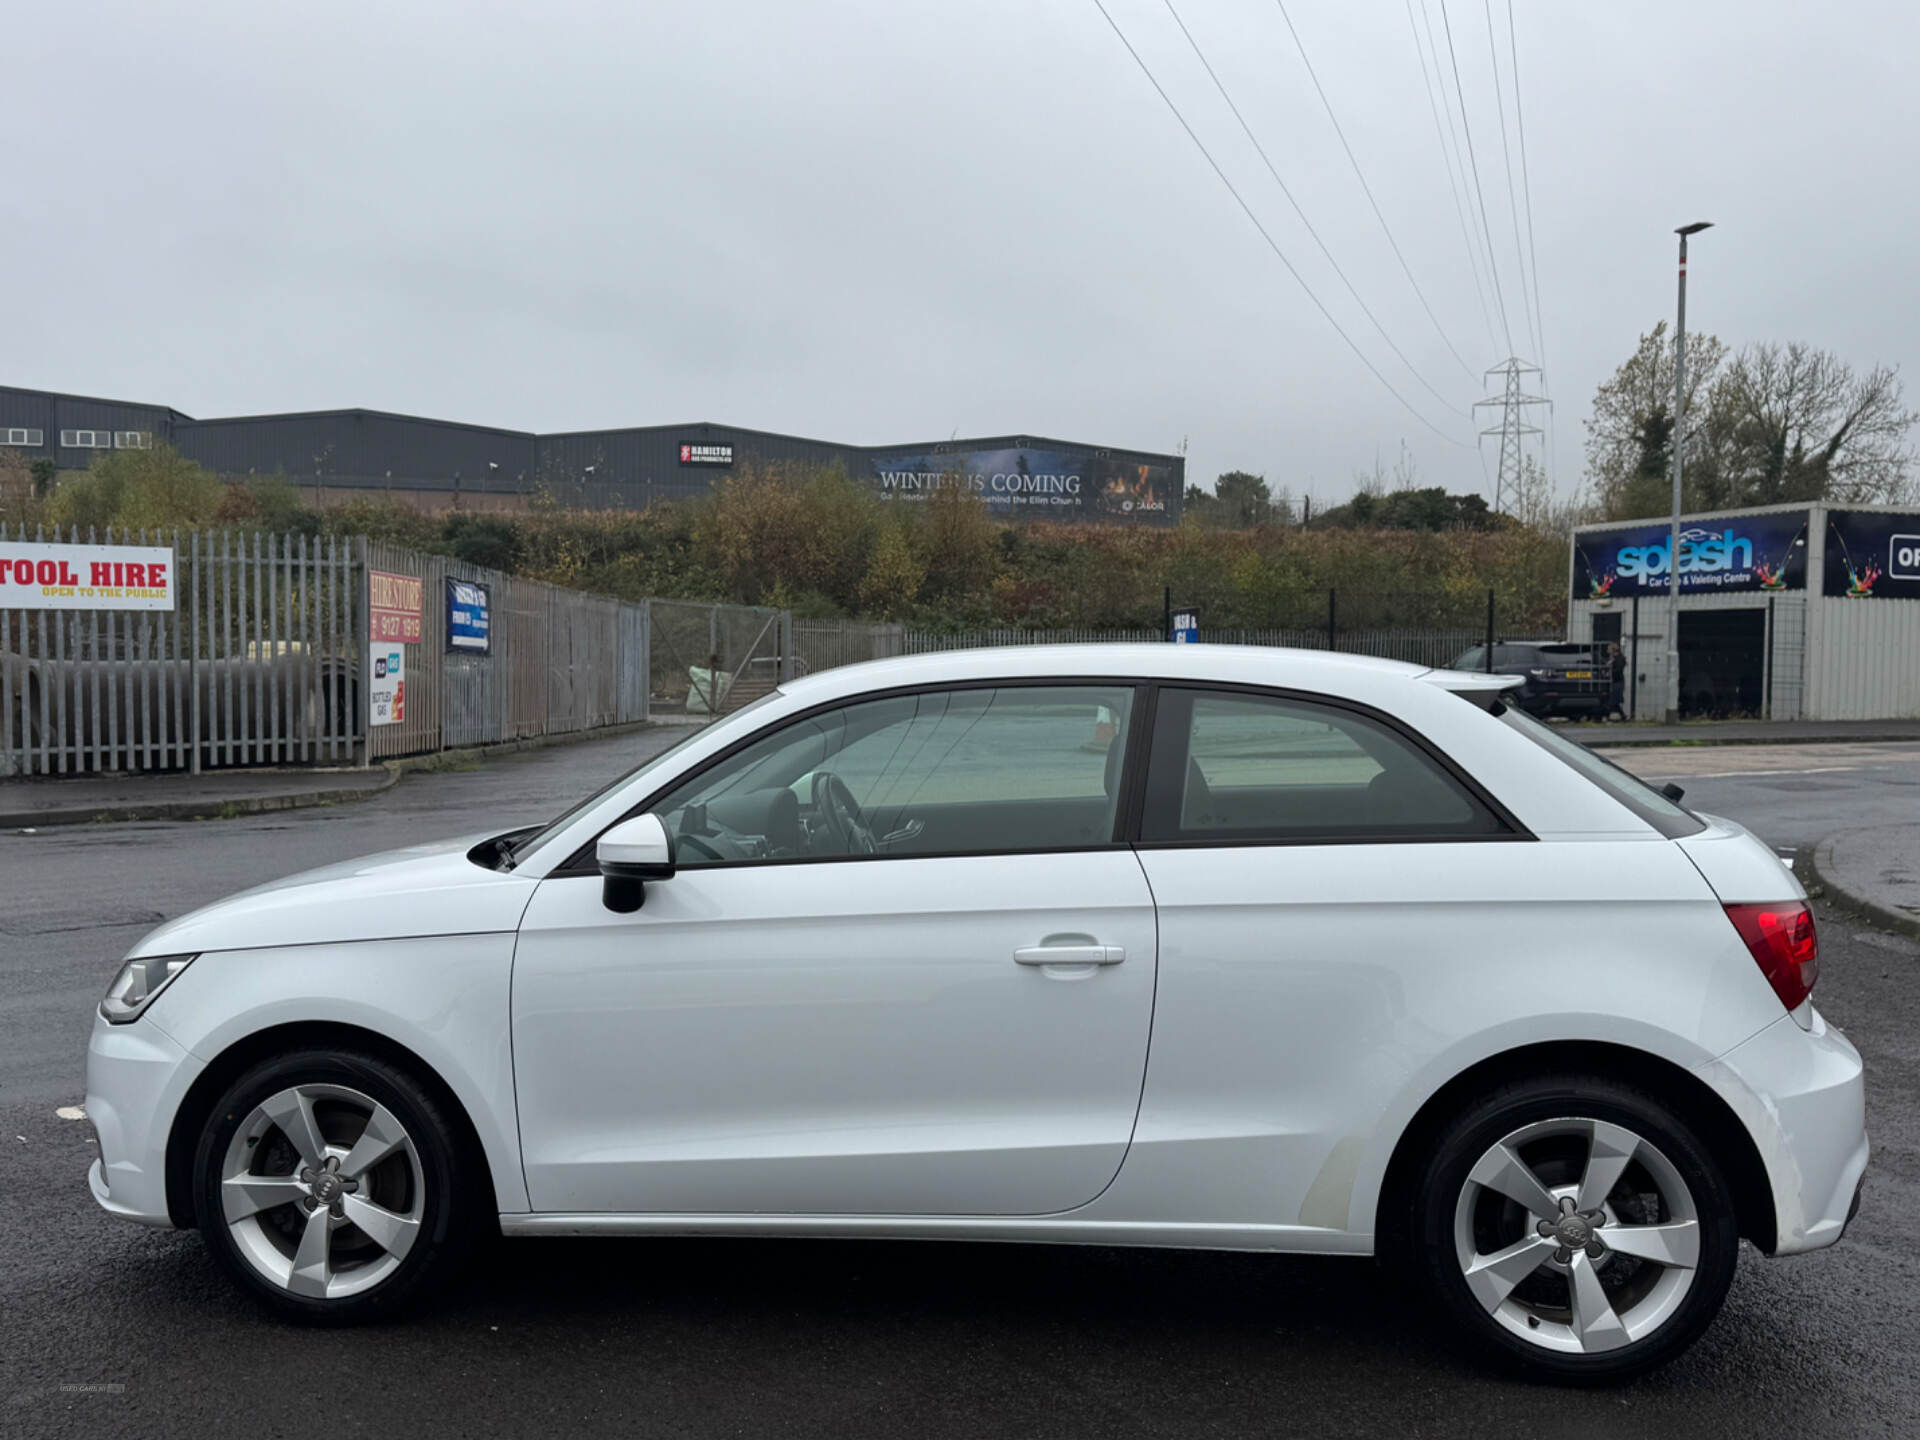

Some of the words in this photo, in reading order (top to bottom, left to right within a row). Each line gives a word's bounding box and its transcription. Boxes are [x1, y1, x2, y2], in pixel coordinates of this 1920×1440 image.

[691, 446, 732, 456] HAMILTON
[991, 473, 1081, 493] COMING
[1013, 496, 1027, 504] the
[1029, 496, 1049, 505] Elim
[1050, 496, 1082, 505] Churh
[0, 559, 79, 586] TOOL
[90, 562, 167, 588] HIRE
[1649, 577, 1662, 587] Car
[1691, 574, 1722, 586] Valeting
[1723, 572, 1751, 583] Centre
[42, 587, 75, 597] OPEN
[78, 587, 95, 597] TO
[98, 588, 122, 598] THE
[126, 588, 167, 599] PUBLIC
